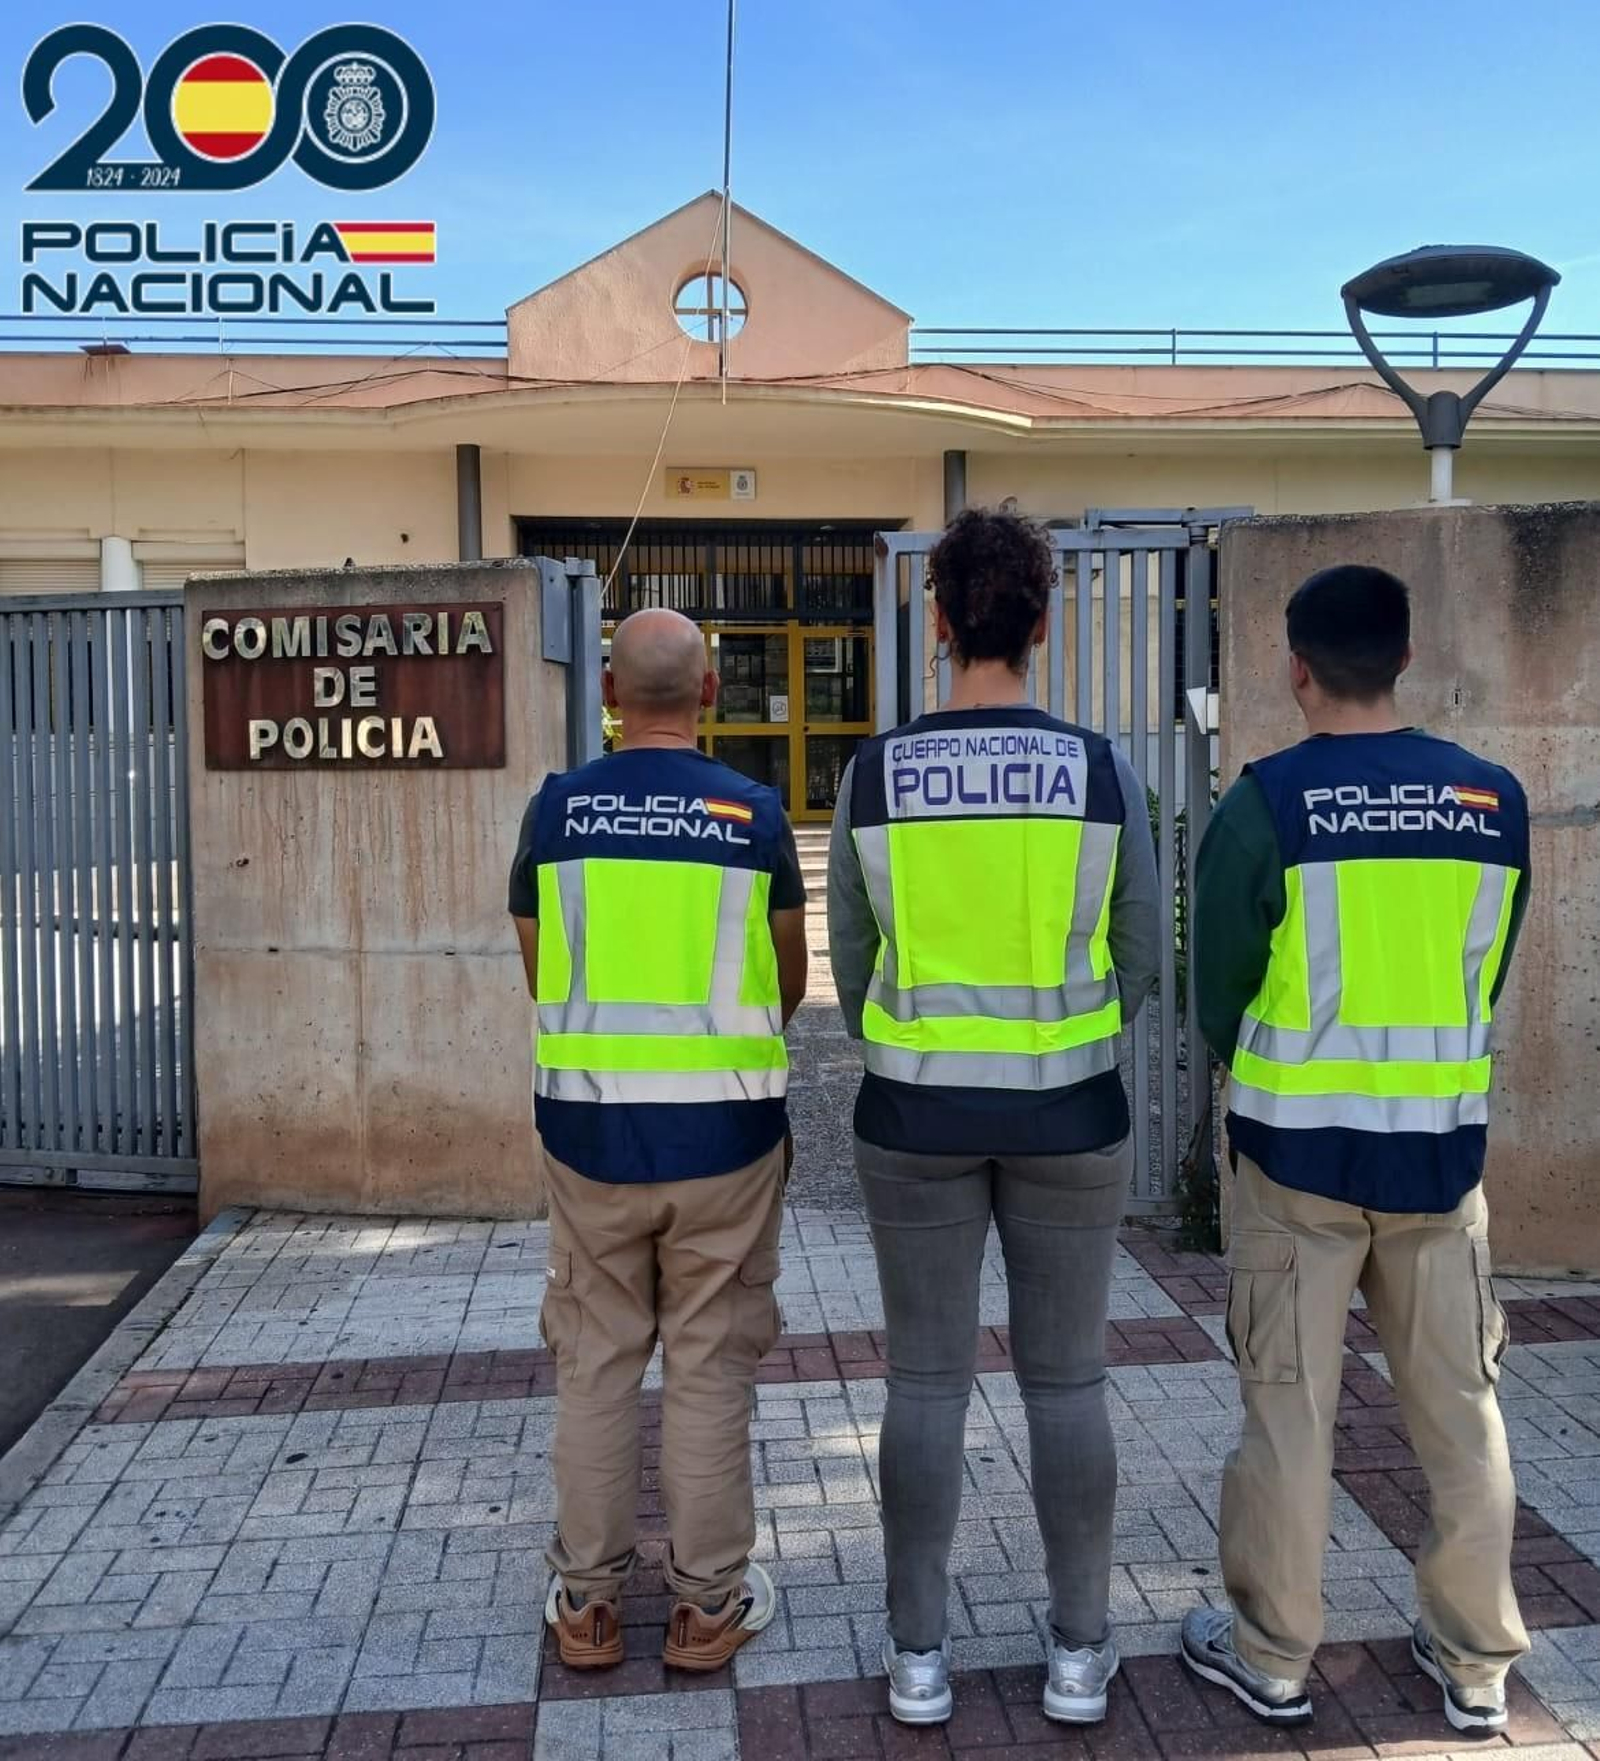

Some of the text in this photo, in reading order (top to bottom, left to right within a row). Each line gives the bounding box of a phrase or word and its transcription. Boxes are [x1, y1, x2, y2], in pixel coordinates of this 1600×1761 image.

[202, 611, 493, 660] COMISARIA
[313, 666, 377, 708] DE
[249, 716, 444, 760] POLICIA
[892, 735, 1079, 762] CUERPO NACIONAL DE
[892, 763, 1076, 808] POLICIA
[565, 816, 750, 845] NACIONAL
[1308, 810, 1501, 837] NACIONAL
